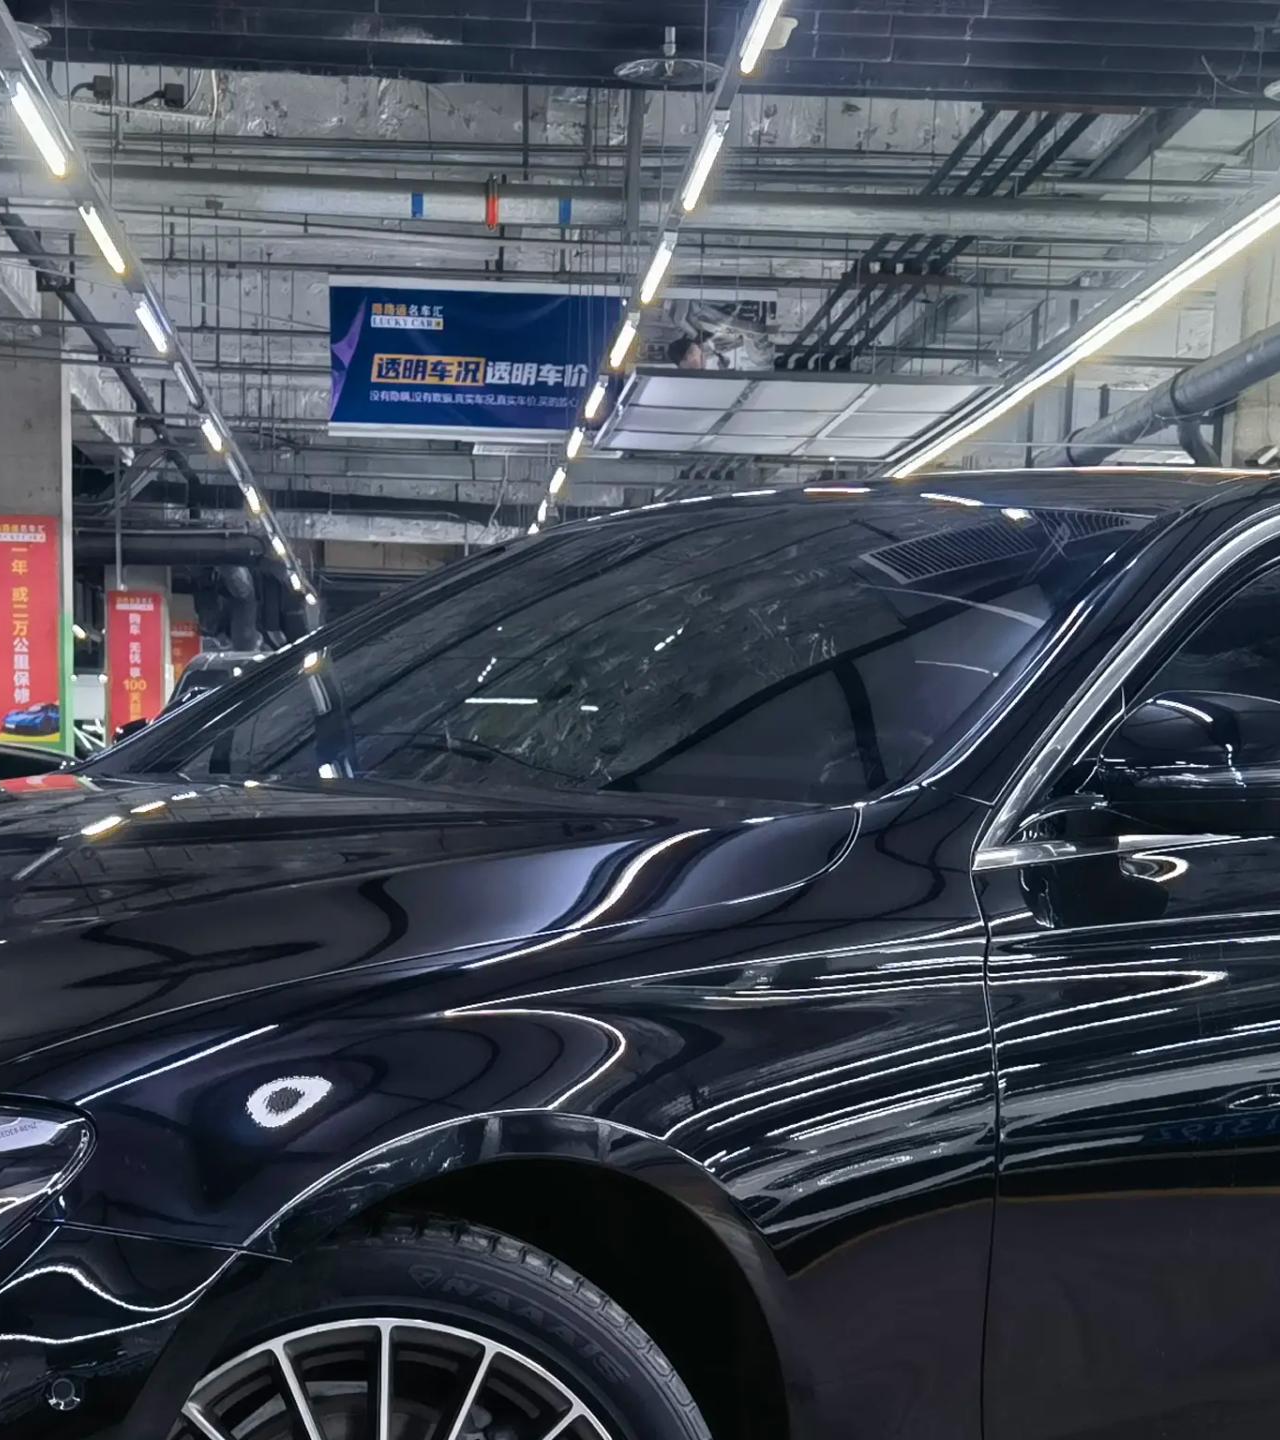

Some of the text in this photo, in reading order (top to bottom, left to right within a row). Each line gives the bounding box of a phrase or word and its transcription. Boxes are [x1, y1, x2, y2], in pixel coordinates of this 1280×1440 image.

[373, 316, 433, 328] LUCKY CAR
[376, 357, 589, 387] 透明车况 透明车价
